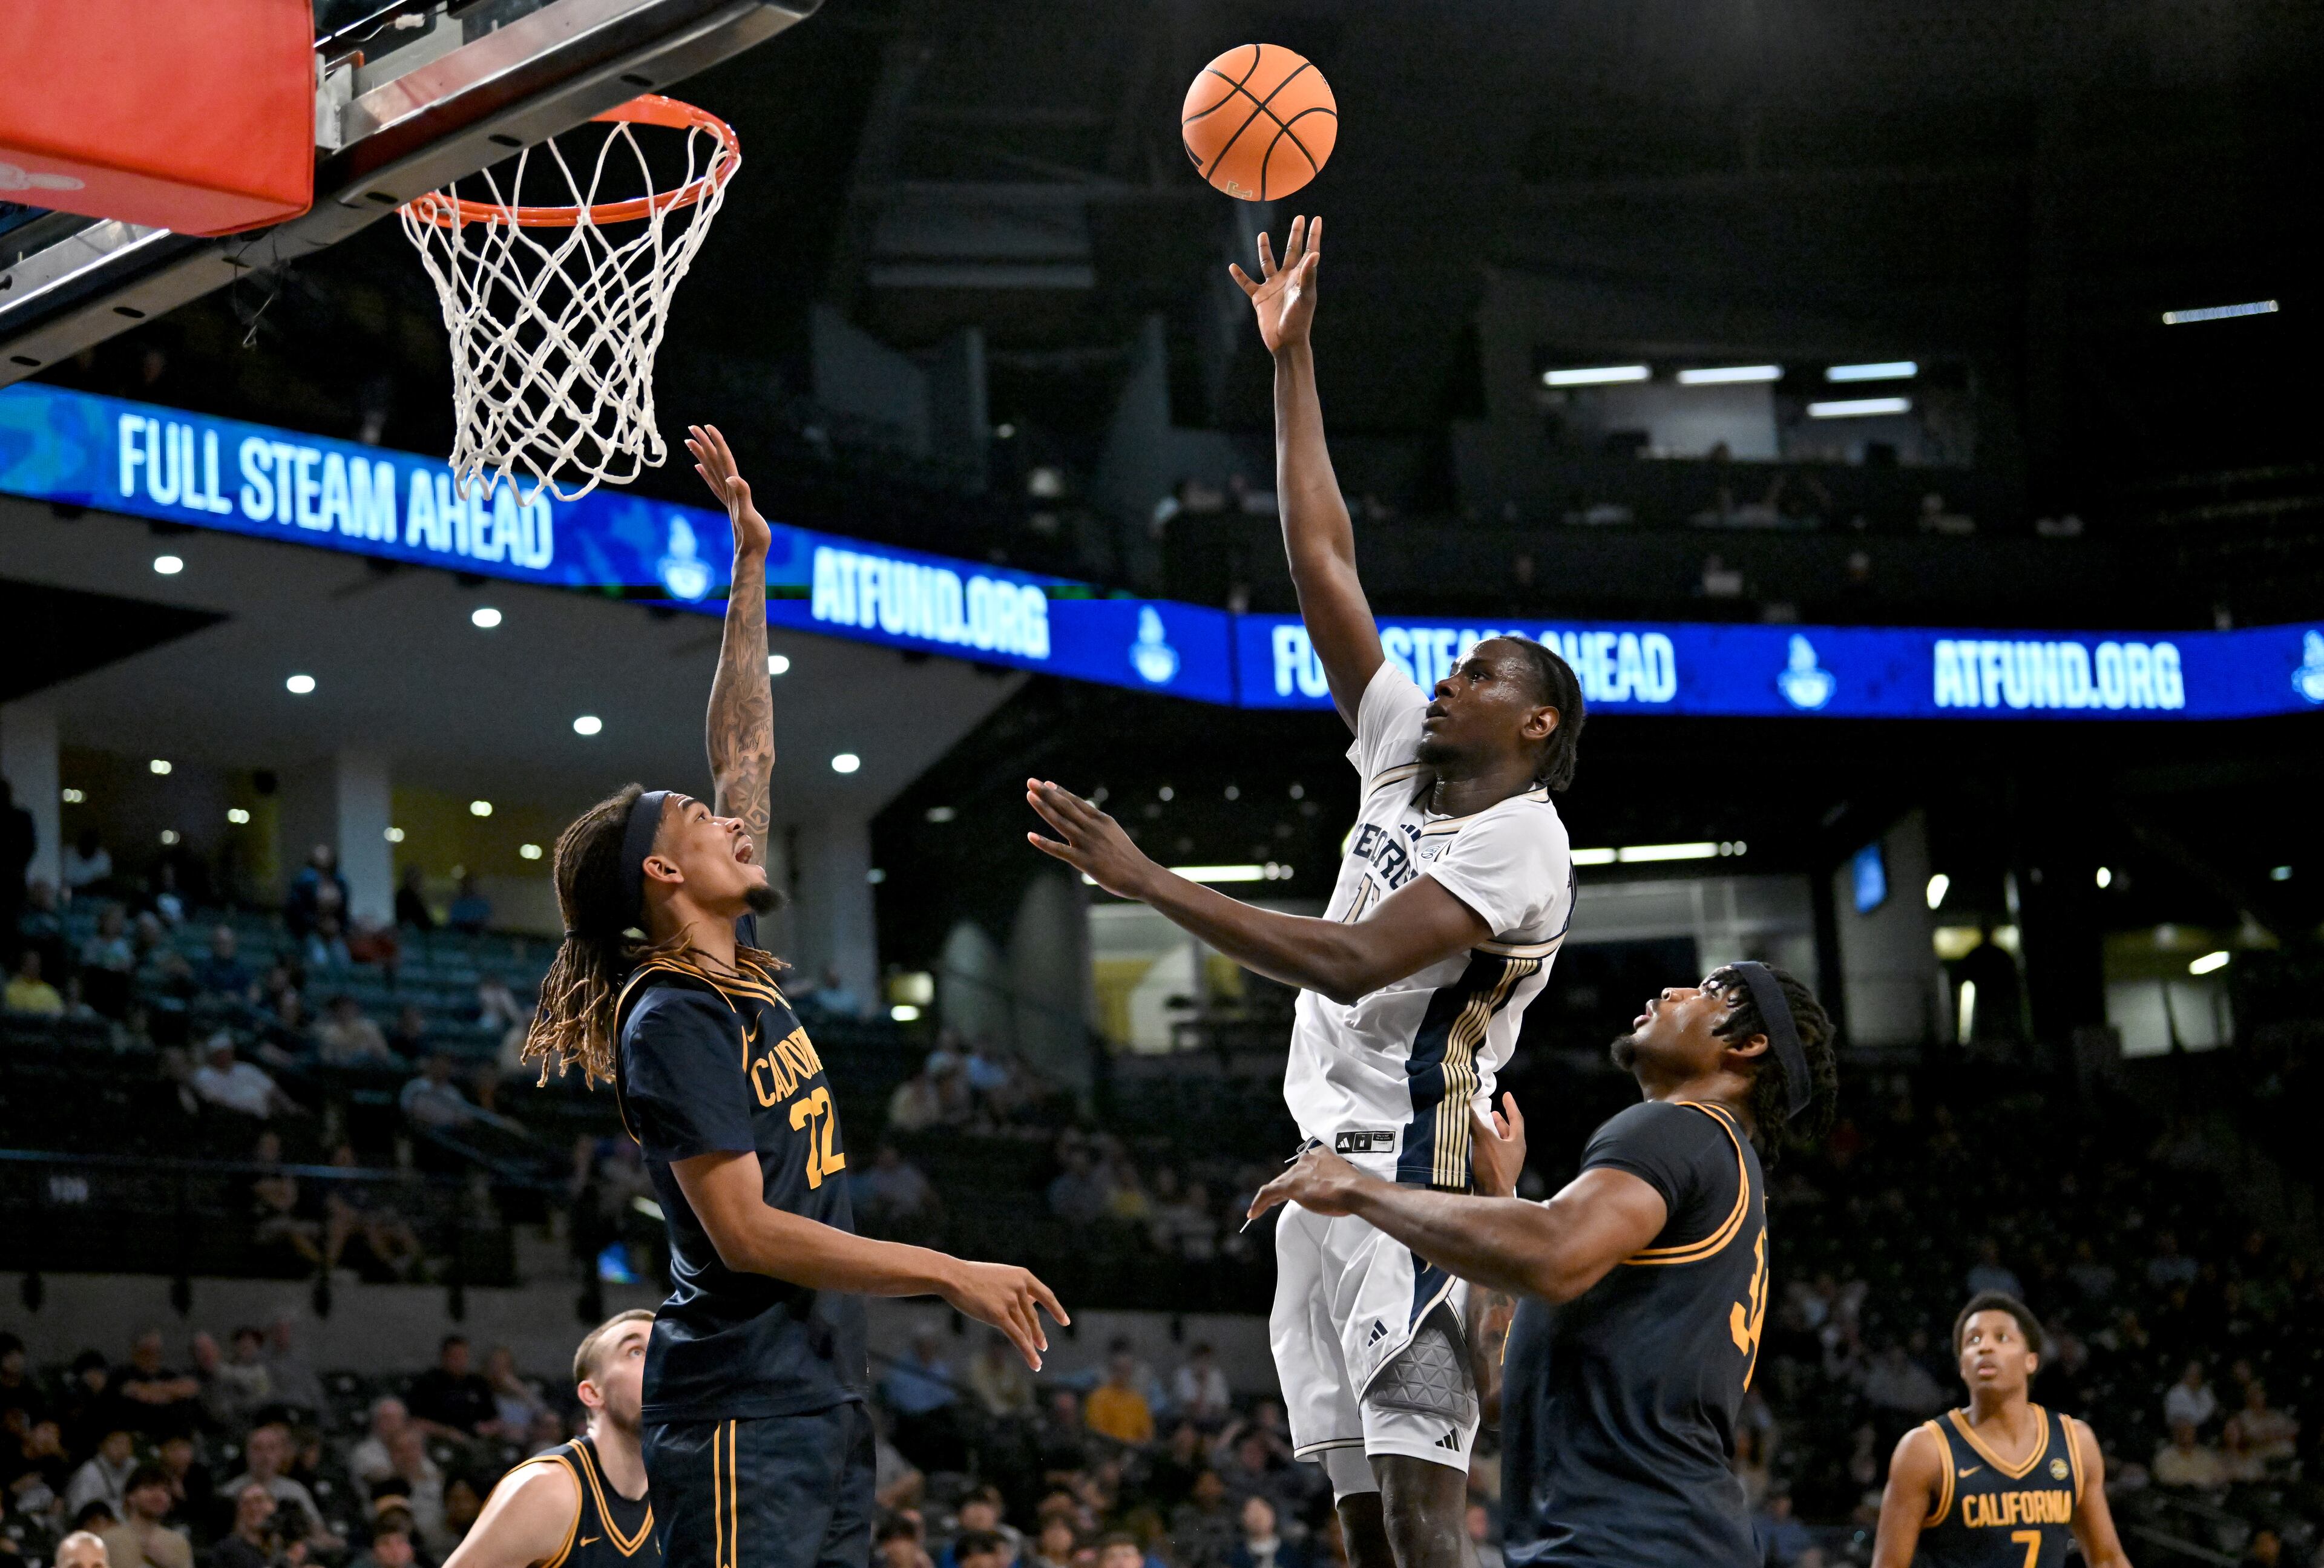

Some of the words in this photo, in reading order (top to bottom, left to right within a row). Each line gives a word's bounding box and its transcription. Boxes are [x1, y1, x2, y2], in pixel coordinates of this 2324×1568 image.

[118, 413, 232, 514] FULL
[240, 436, 397, 542] STEAM
[406, 468, 553, 569] AHEAD
[812, 545, 1051, 660] ATFUND.ORG
[1934, 639, 2185, 709] ATFUND.ORG
[789, 1086, 846, 1190] 22
[2011, 1530, 2042, 1568] 7
